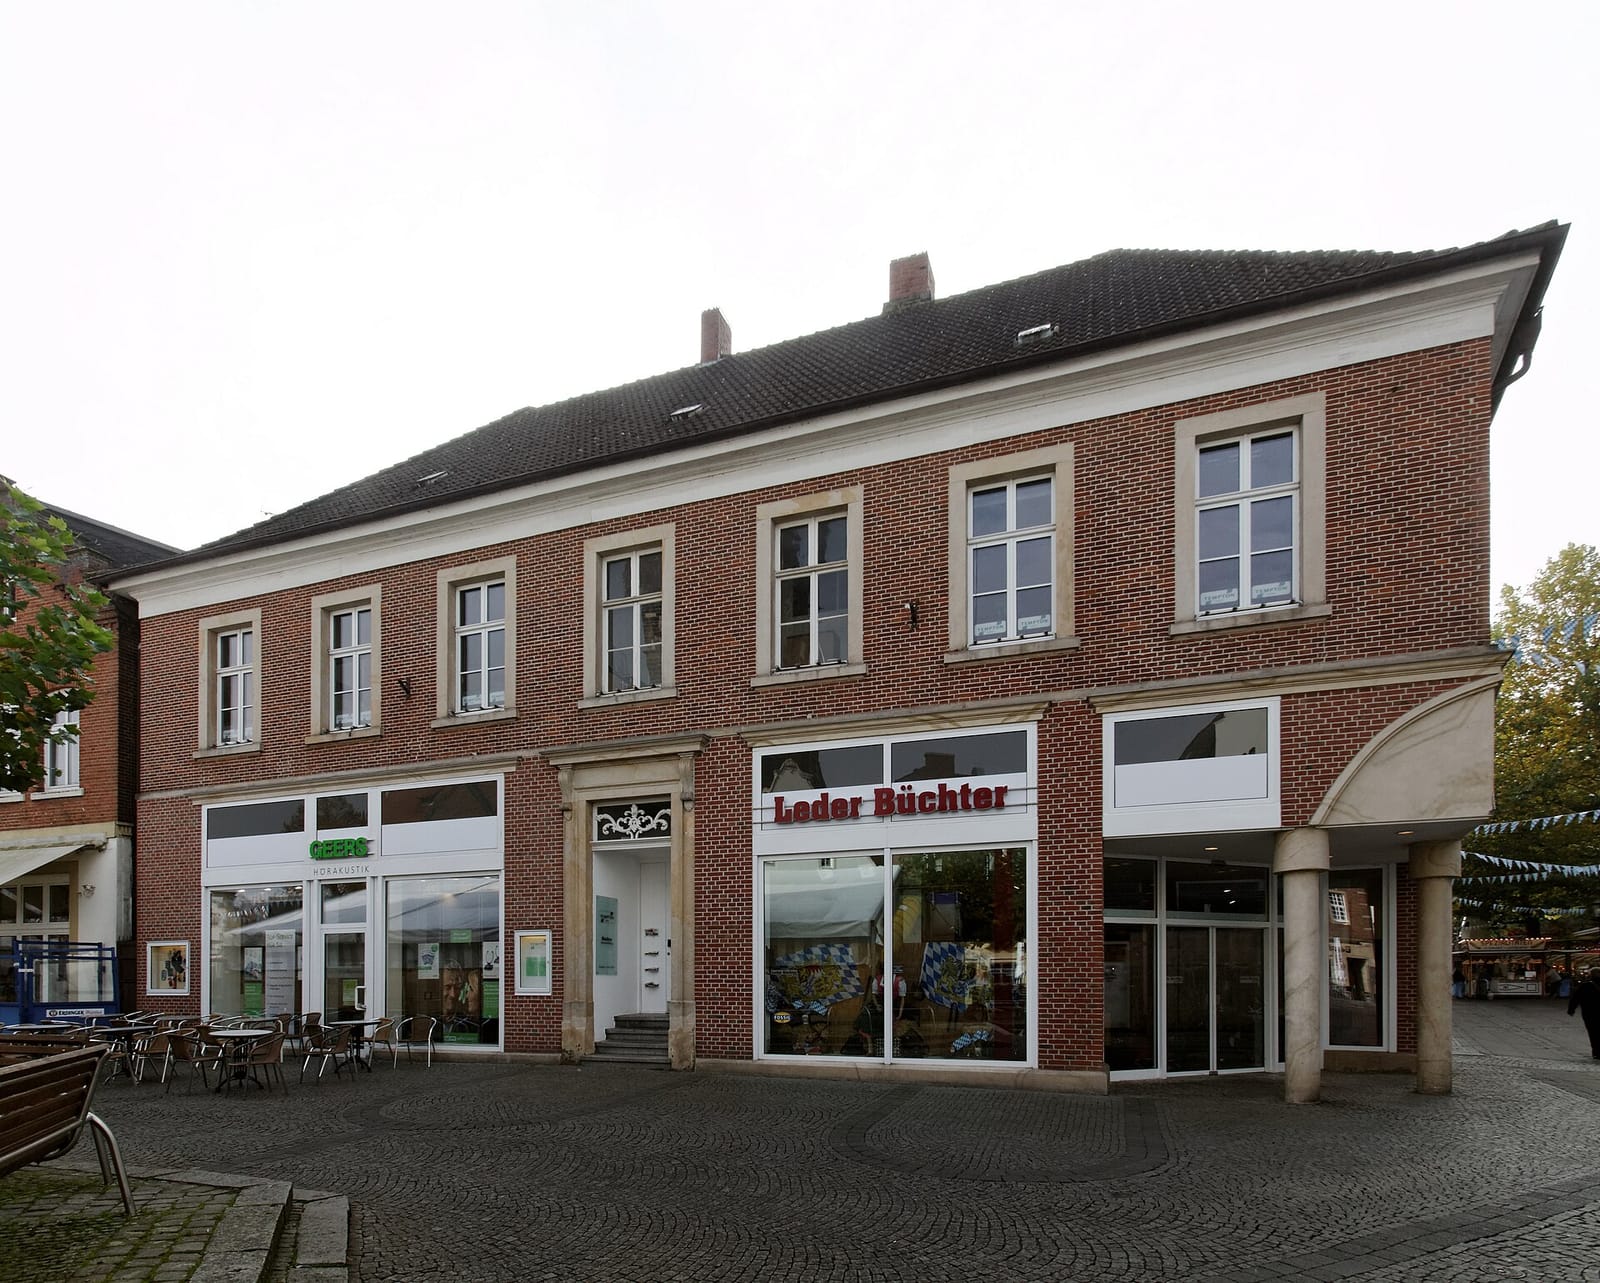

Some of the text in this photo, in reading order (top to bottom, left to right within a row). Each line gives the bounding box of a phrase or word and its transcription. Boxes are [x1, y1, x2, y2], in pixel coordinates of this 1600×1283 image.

[774, 783, 1008, 824] Leder Büchter
[310, 837, 368, 859] GEERS
